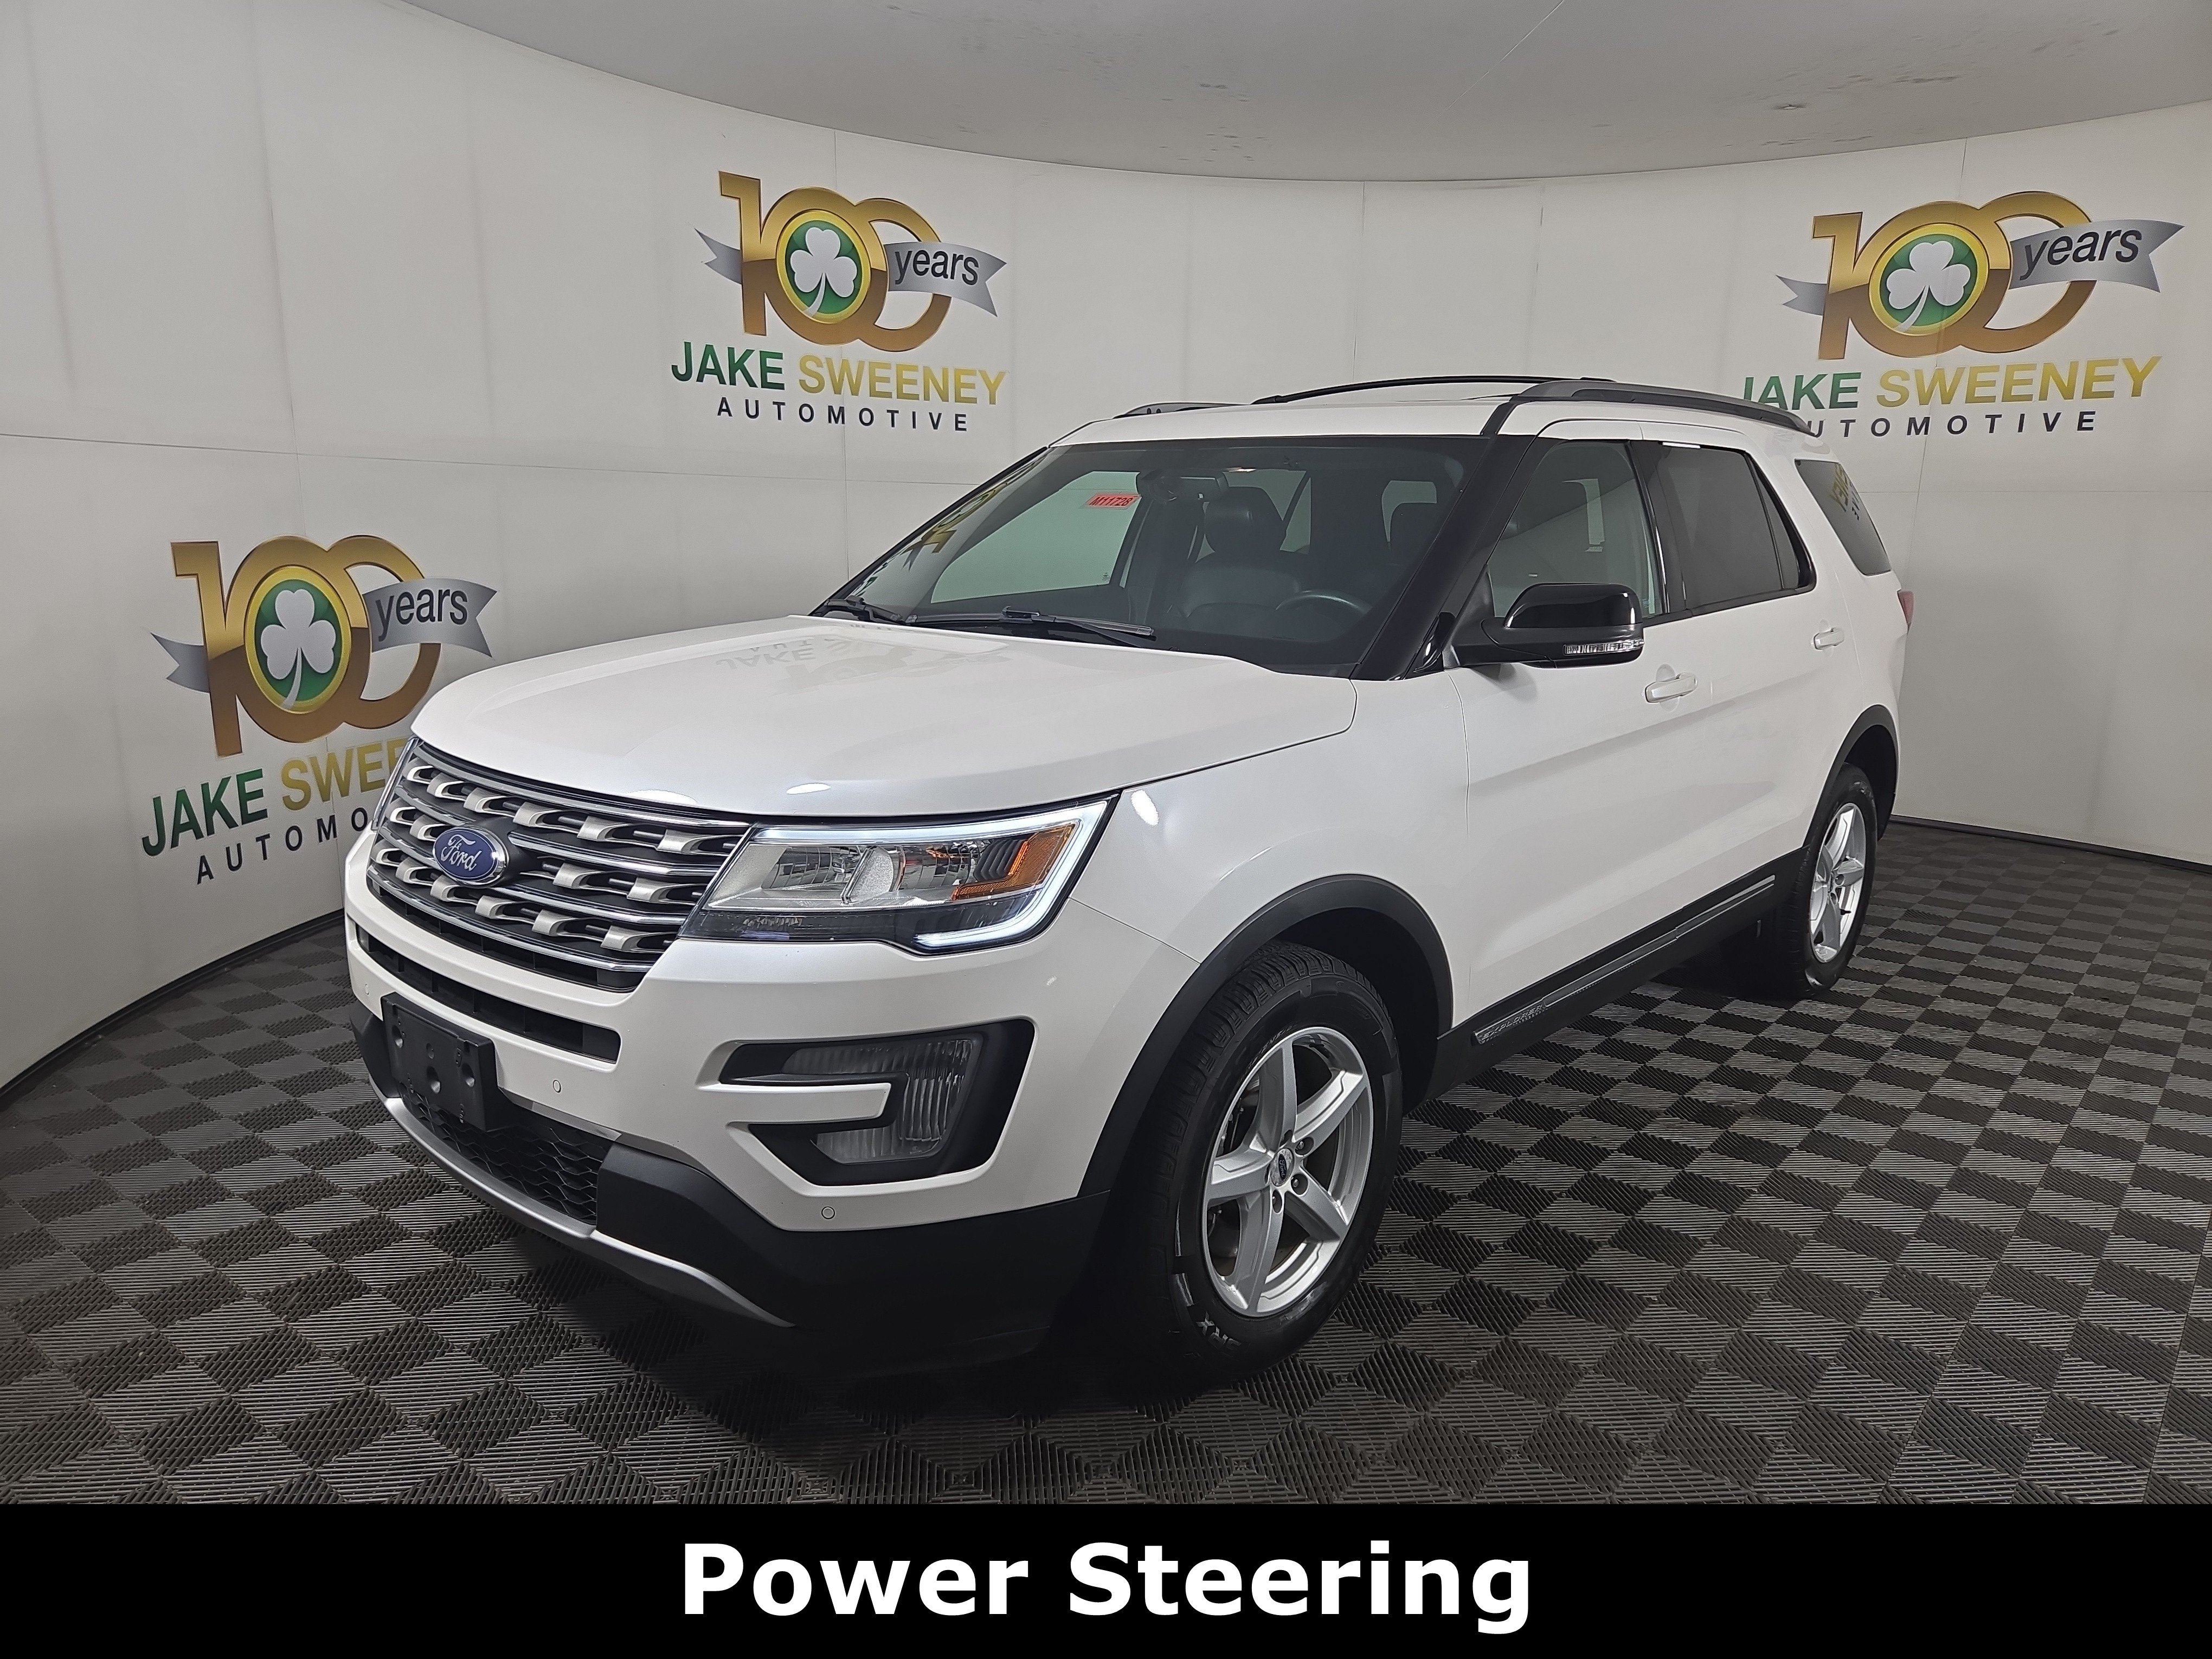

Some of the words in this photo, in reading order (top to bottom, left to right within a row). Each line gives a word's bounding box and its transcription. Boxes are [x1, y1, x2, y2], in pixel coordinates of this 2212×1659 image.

[718, 170, 953, 352] 100
[894, 249, 980, 285] years
[1812, 190, 2098, 361] 100
[2020, 228, 2143, 280] years
[671, 340, 785, 390] JAKE
[798, 354, 1007, 405] SWEENEY
[1876, 355, 2163, 409] SWEENEY
[717, 396, 967, 431] AUTOMOTIVE
[1806, 410, 2096, 438] UTOMOTIVE
[170, 535, 441, 757] 100
[376, 588, 468, 641] years
[142, 768, 268, 857] JAKE
[197, 807, 369, 885] AUTOMO
[441, 834, 482, 871] Ford
[1482, 1004, 1542, 1040] EXPLORER
[1279, 1159, 1287, 1178] Ford
